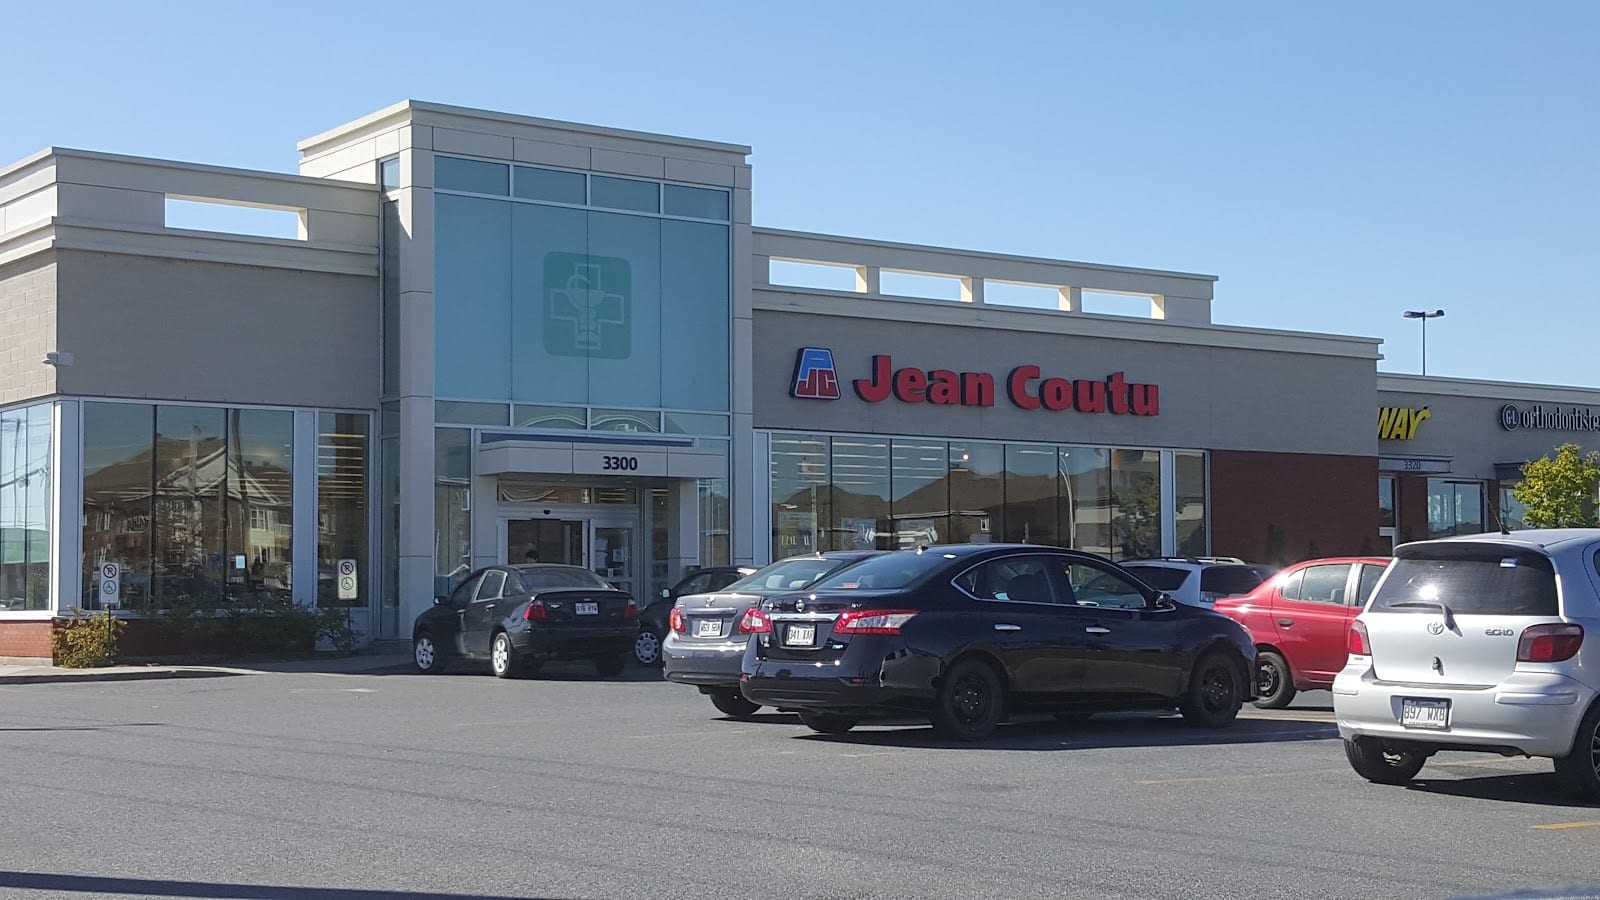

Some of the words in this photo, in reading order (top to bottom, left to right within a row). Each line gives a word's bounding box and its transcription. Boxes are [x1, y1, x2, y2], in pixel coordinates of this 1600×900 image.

[853, 354, 995, 407] Jean
[1006, 364, 1160, 416] Coutu
[602, 455, 638, 471] 3300
[1403, 460, 1422, 471] 3320
[1485, 629, 1514, 637] ECHO
